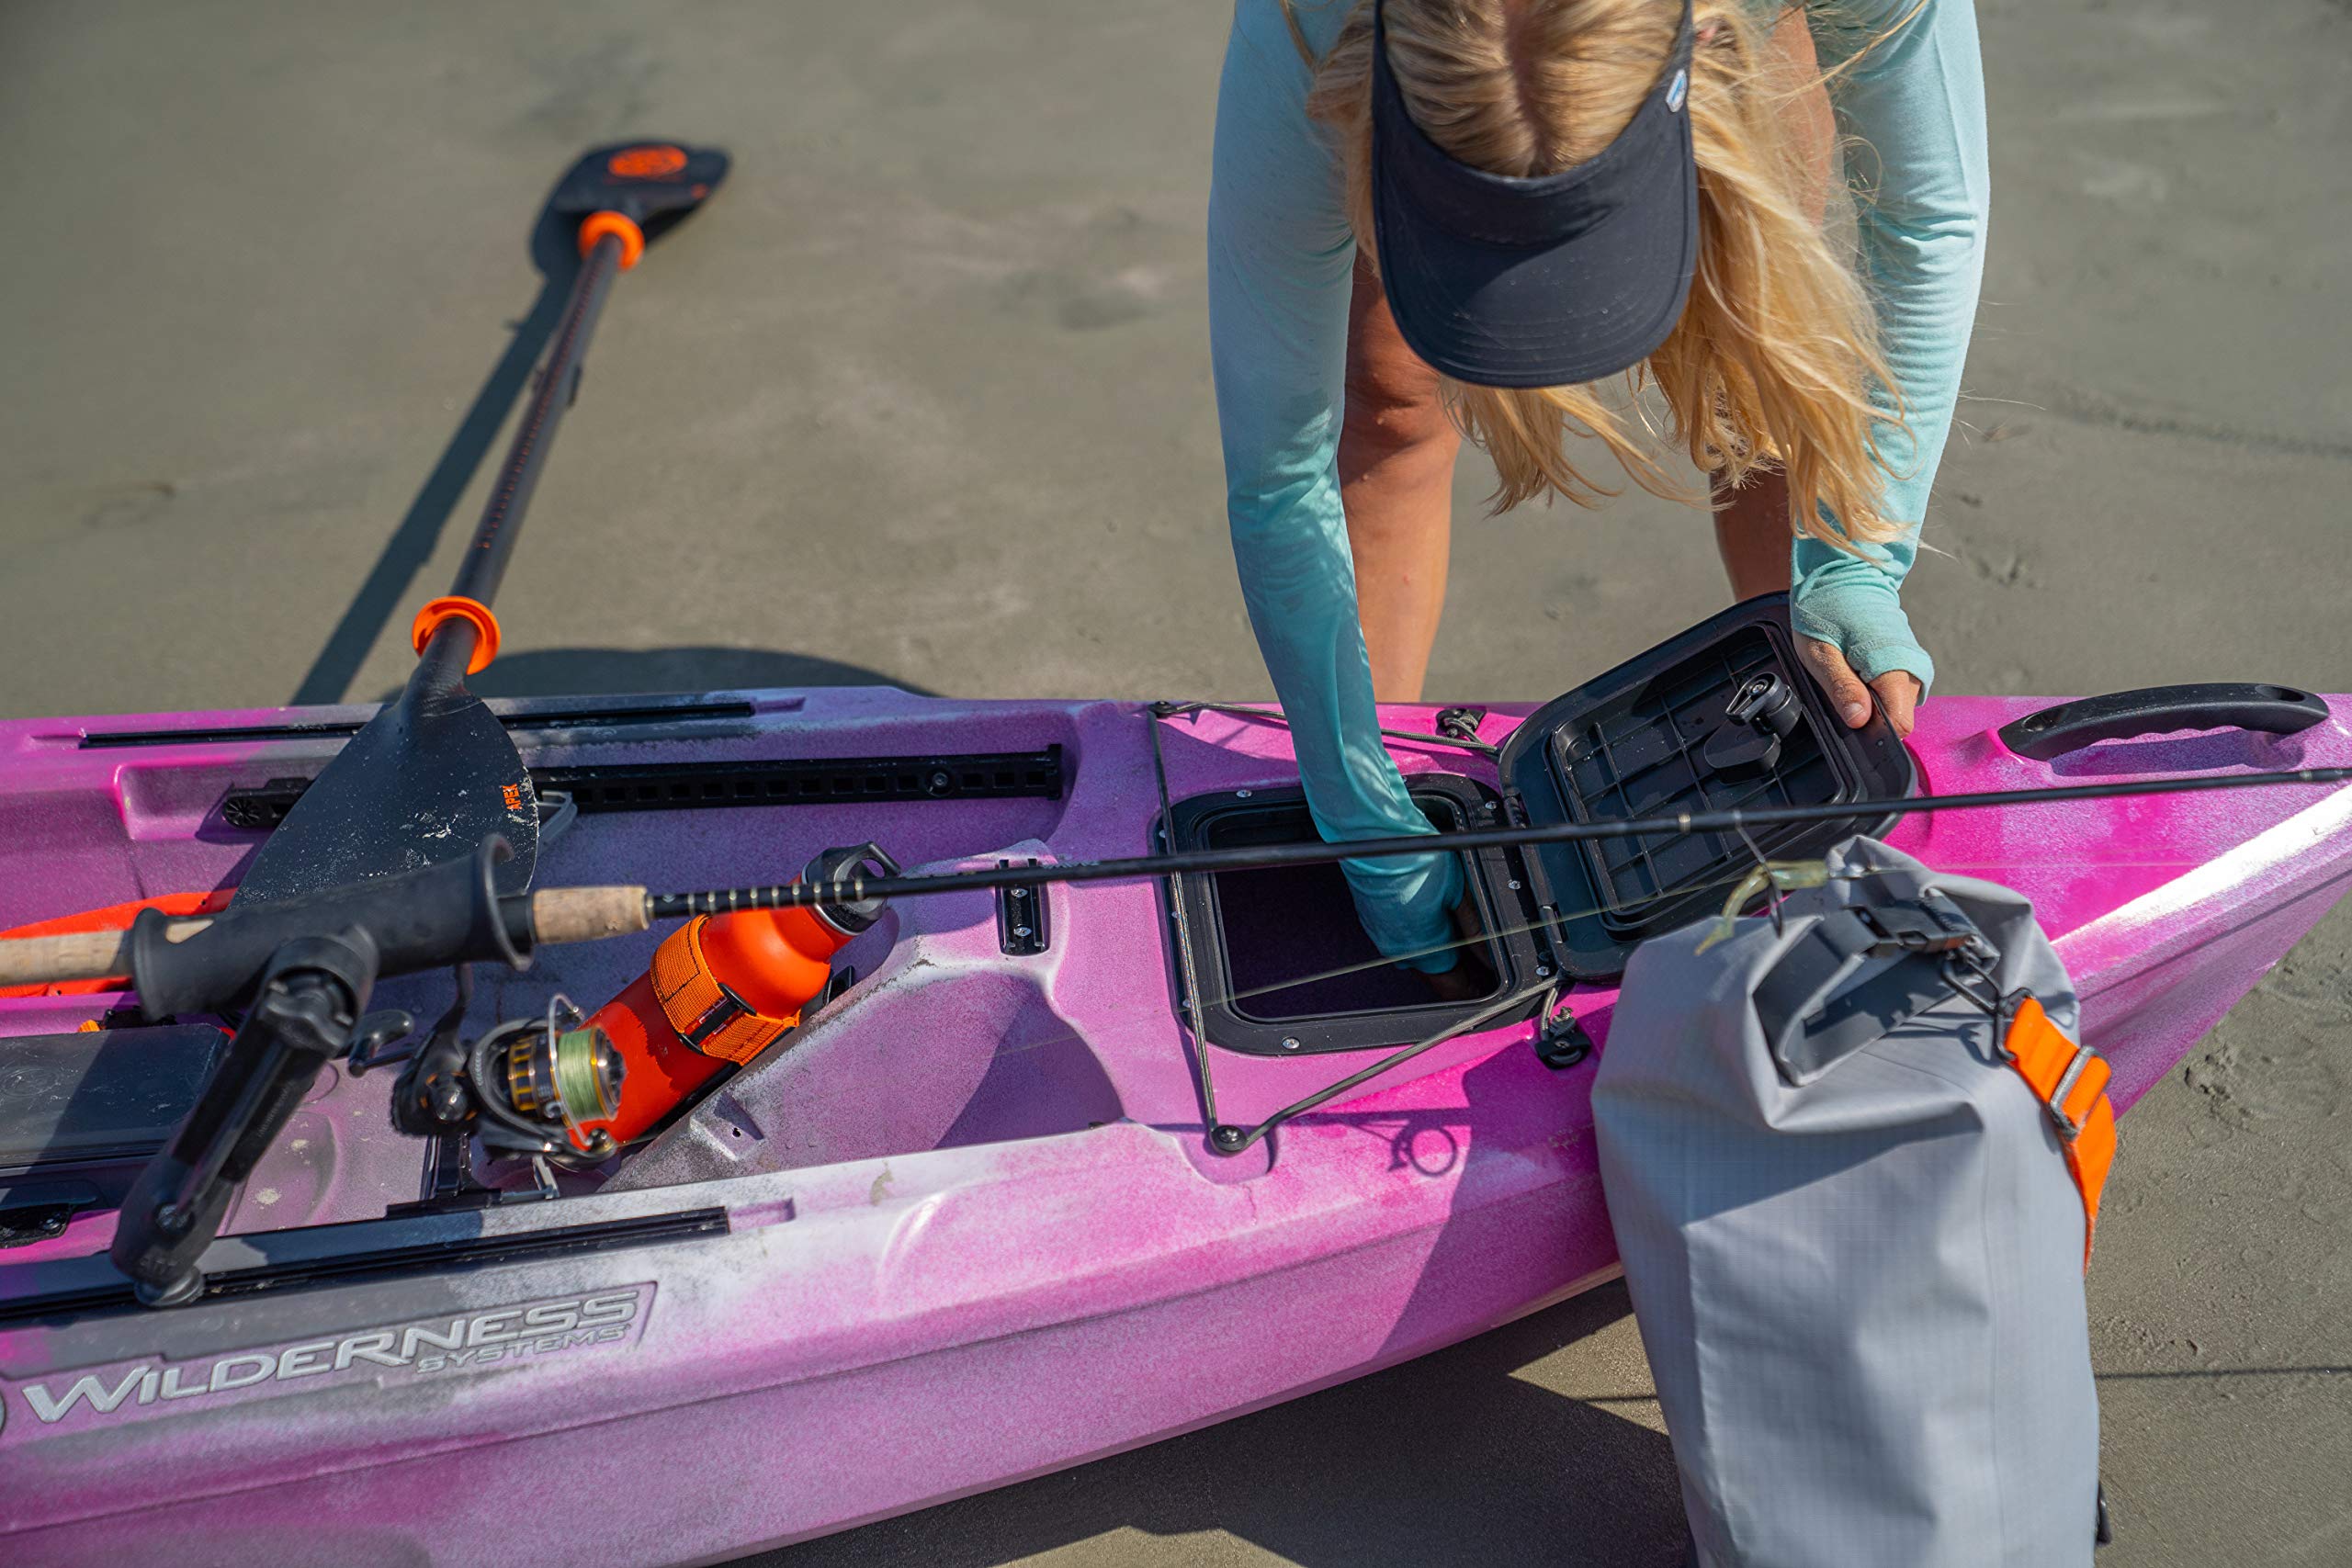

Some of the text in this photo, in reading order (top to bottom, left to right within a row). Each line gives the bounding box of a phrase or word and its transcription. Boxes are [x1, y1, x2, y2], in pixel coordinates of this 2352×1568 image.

[502, 783, 523, 810] APEX
[22, 1291, 639, 1424] WILDERNESS
[417, 1325, 627, 1374] SYSTEMS
